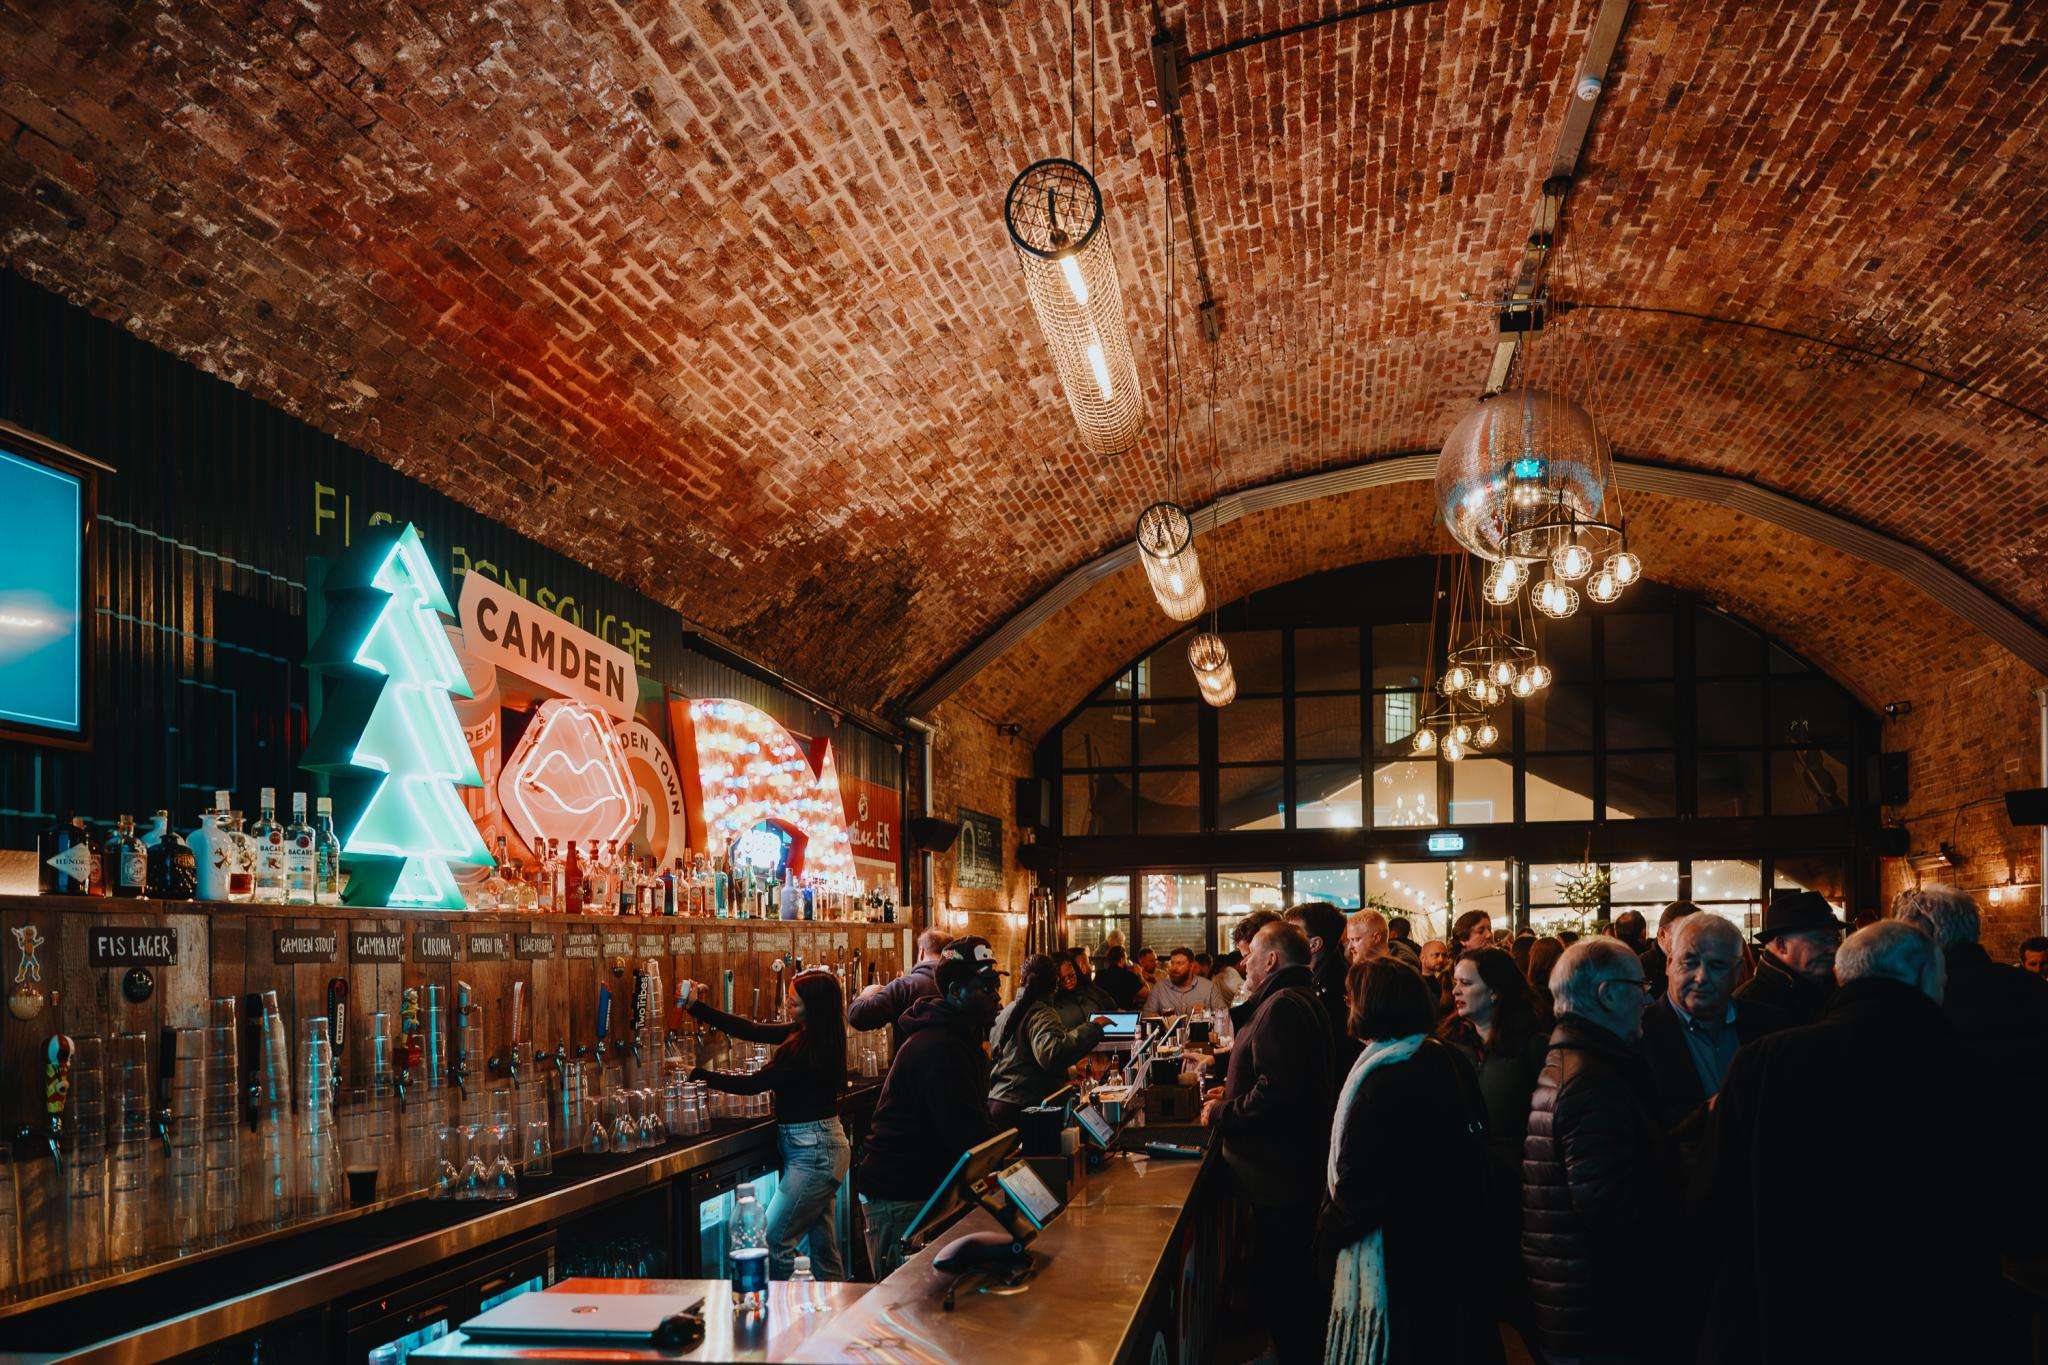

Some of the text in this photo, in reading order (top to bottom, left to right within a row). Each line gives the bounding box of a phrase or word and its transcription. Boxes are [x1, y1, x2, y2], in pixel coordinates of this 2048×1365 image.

[476, 597, 625, 702] CAMDEN
[654, 746, 681, 815] TOWN
[98, 935, 171, 957] FIS LAGER
[280, 936, 336, 953] CAMDEN STOUT
[356, 936, 402, 957] GAMMA RAY
[422, 937, 452, 956] CORONA
[636, 974, 651, 1030] TwoTribes
